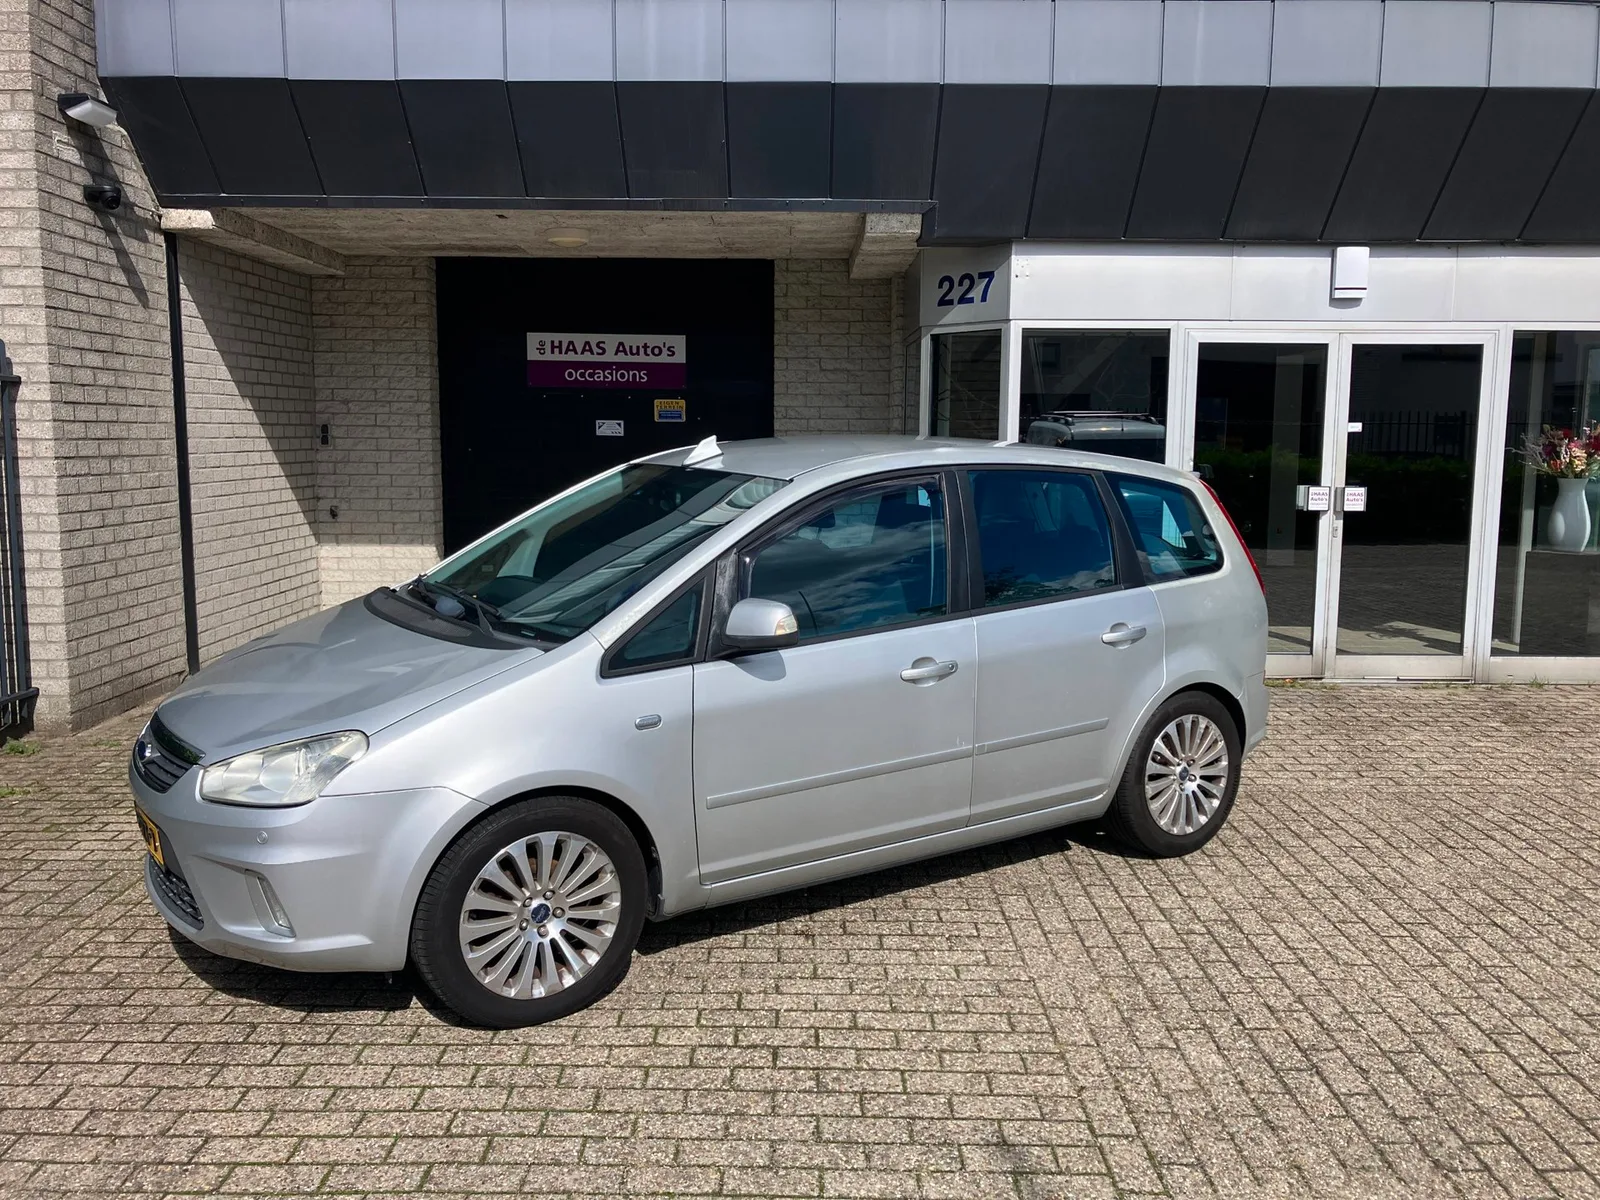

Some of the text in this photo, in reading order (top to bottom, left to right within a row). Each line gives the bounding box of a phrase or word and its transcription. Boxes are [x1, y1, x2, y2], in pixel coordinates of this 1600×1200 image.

[937, 271, 995, 307] 227
[536, 340, 676, 357] de HAAS Auto's
[564, 366, 648, 382] occasions
